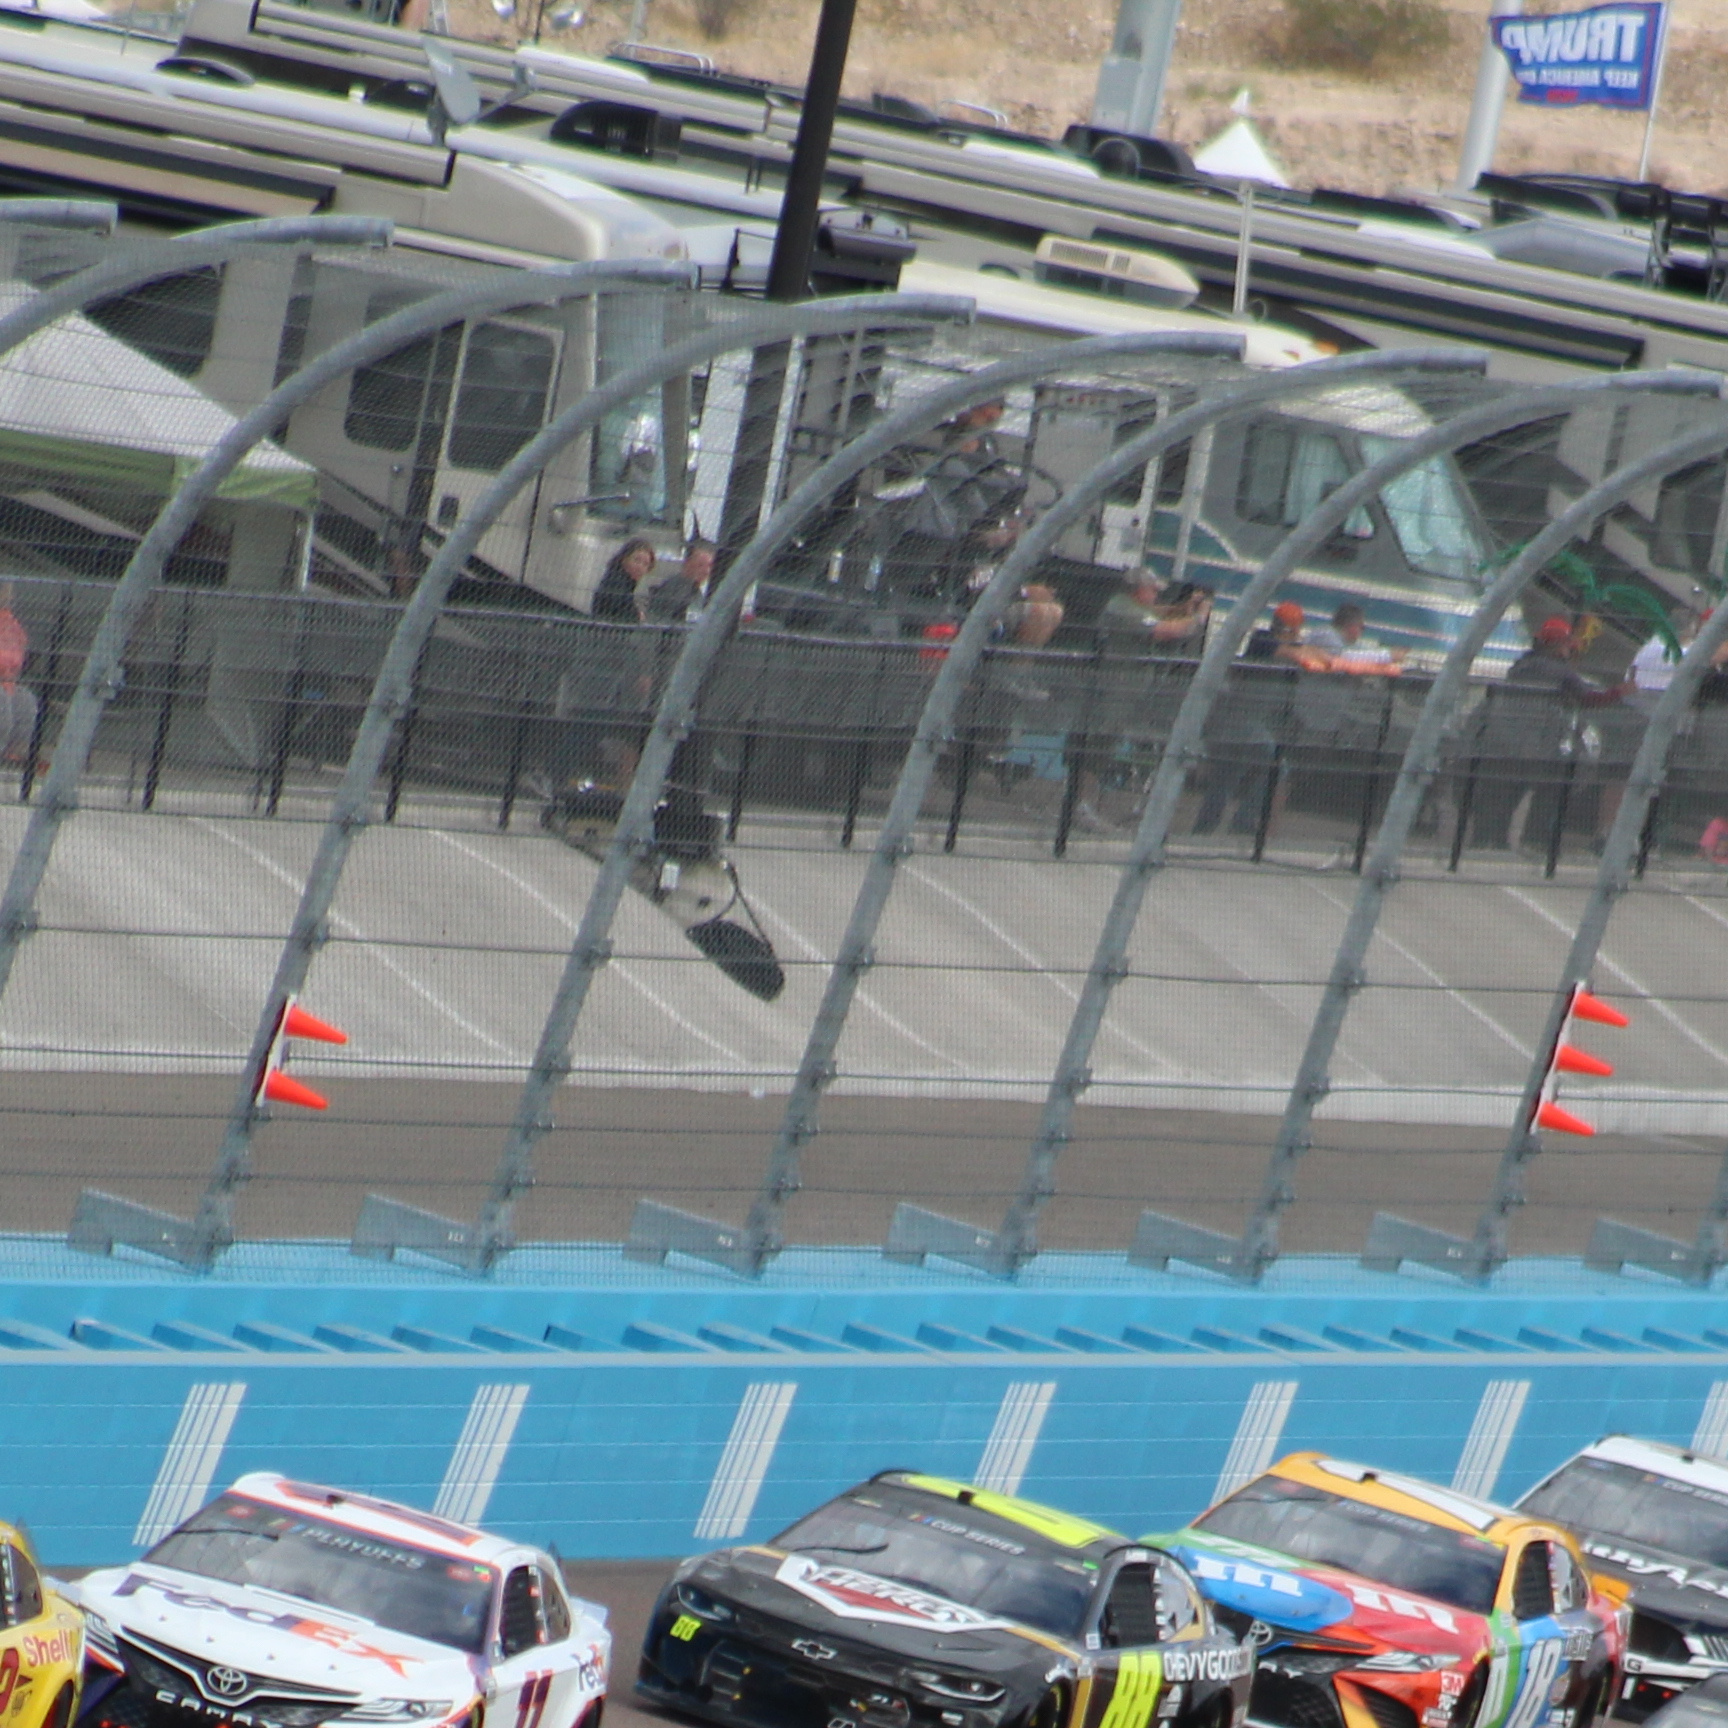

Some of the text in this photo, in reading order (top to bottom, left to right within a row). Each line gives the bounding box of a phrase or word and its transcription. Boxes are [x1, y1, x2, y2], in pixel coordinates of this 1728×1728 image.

[930, 1519, 1026, 1555] CUP SERIES
[669, 1614, 703, 1642] 88
[22, 1628, 71, 1668] Shell
